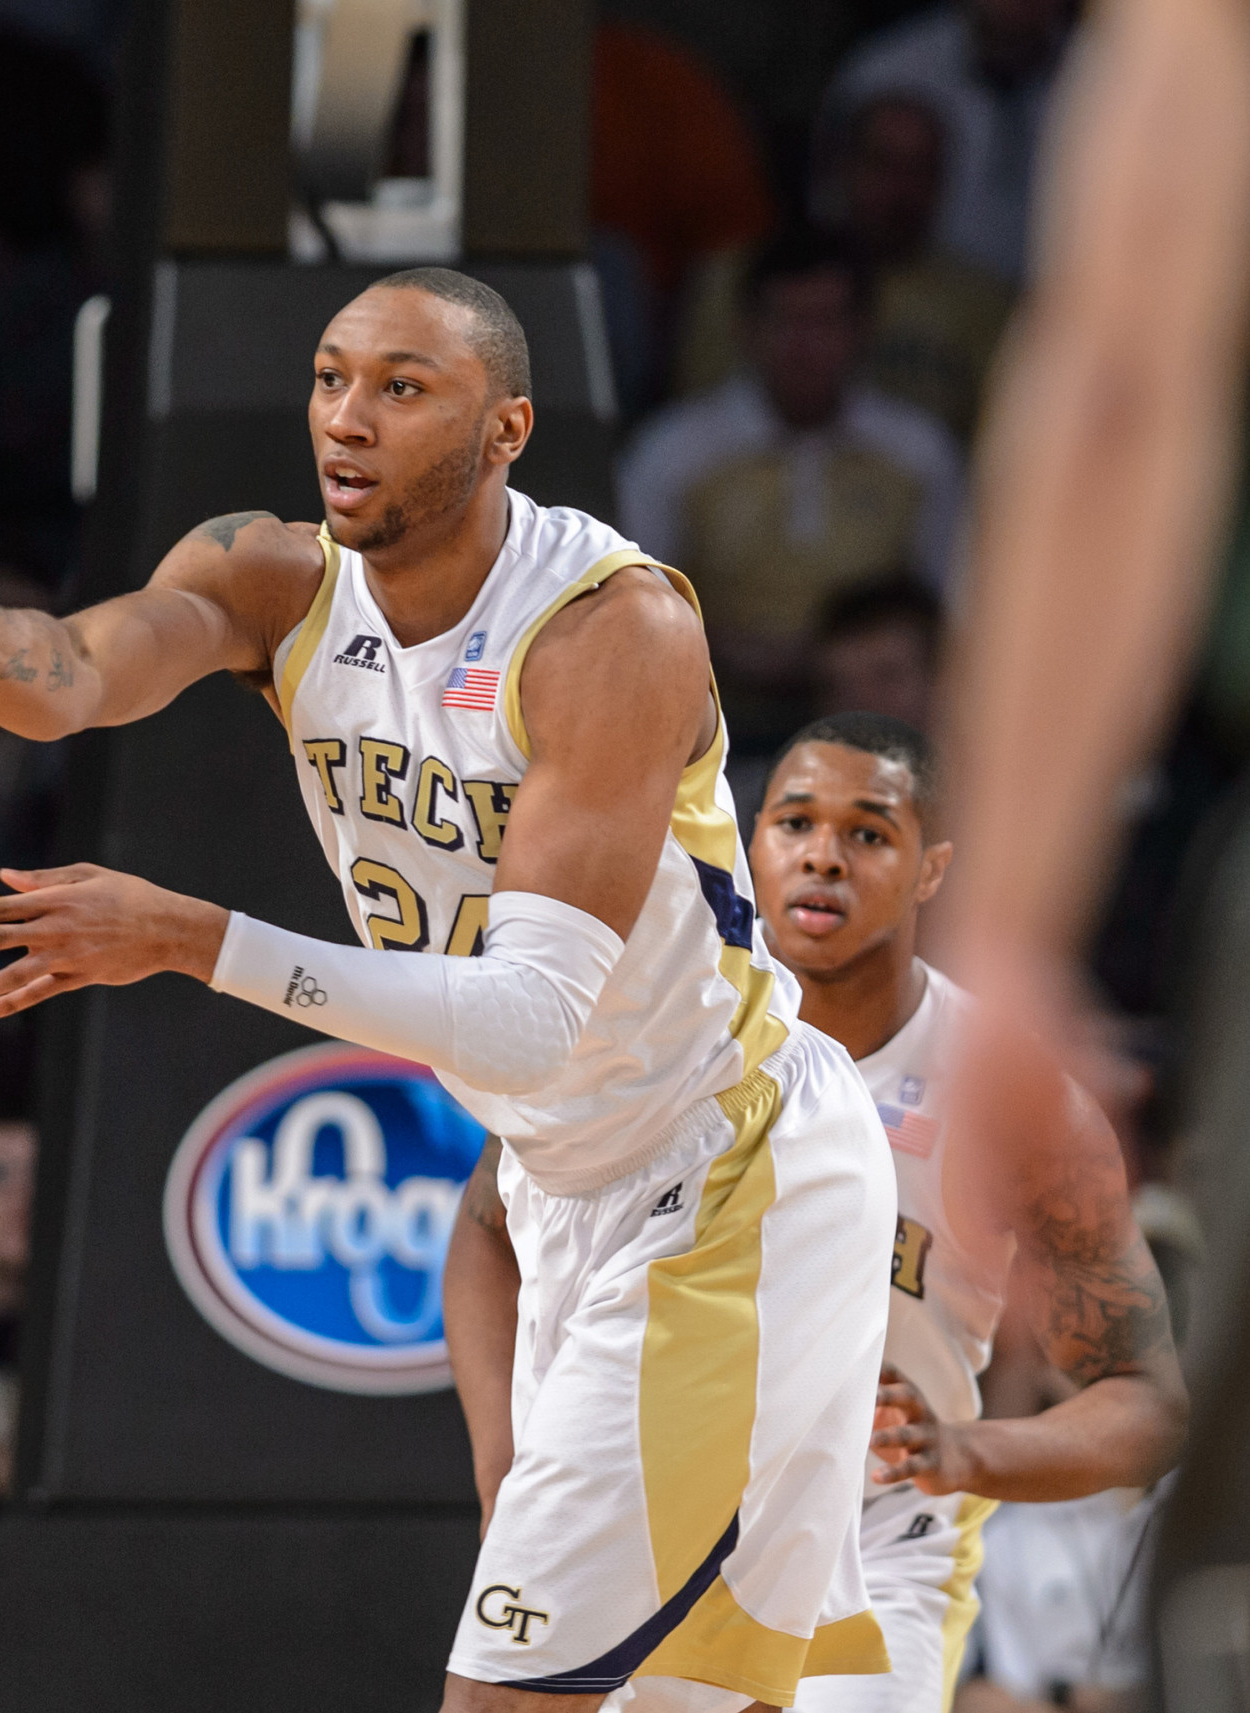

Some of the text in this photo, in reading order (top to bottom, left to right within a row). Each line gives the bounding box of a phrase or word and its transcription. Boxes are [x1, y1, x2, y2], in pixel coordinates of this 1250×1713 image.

[333, 654, 386, 673] RUSSELL
[302, 736, 520, 865] TECH
[227, 1090, 466, 1345] Krog
[475, 1583, 549, 1645] GT
